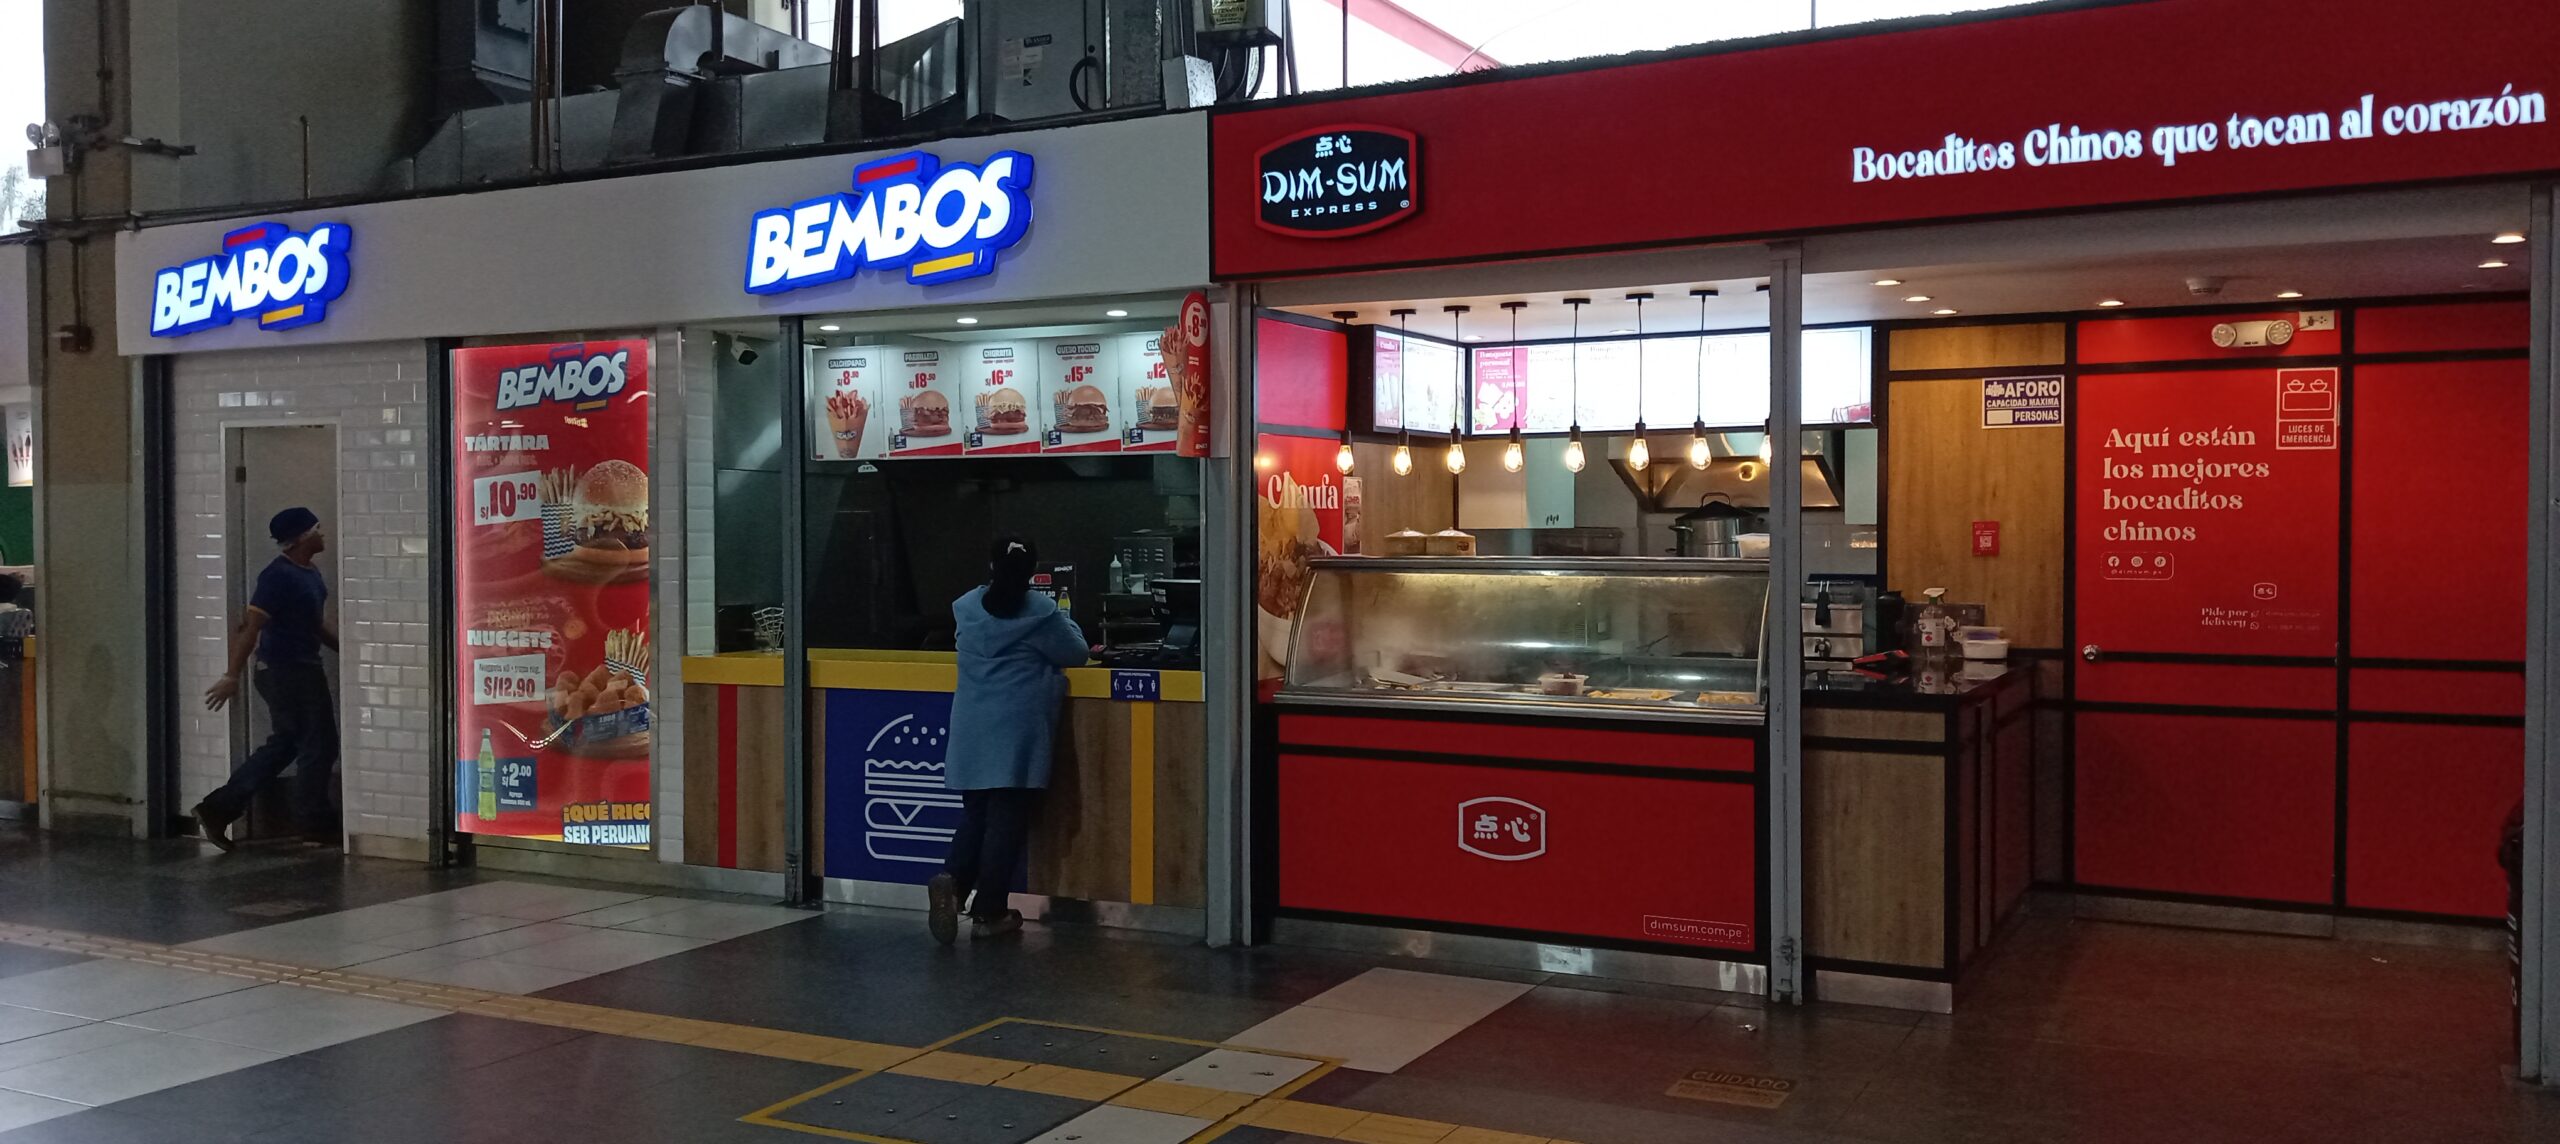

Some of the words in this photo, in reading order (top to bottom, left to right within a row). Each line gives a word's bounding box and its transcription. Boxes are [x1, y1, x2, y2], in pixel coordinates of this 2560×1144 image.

[1853, 133, 2015, 183] Bocaditos
[2024, 123, 2143, 167] Chinos
[2152, 122, 2218, 167] que
[2227, 112, 2331, 150] tocan
[2340, 94, 2374, 140] al
[2382, 83, 2547, 136] corazón
[1262, 157, 1406, 204] DIM-SUM
[1291, 202, 1378, 217] EXPRESS
[749, 156, 1014, 288] BEMBOS
[152, 228, 330, 332] BEMBOS
[496, 351, 628, 410] BEMBOS
[2004, 380, 2060, 398] AFORO
[1986, 399, 2027, 409] CAPACIDAD
[2029, 397, 2059, 407] MAXIMA
[2014, 410, 2059, 422] PERSONAS
[2288, 425, 2313, 433] LUCES
[2315, 425, 2325, 433] DE
[464, 433, 550, 452] TÁRTARA
[2104, 427, 2169, 454] Aquí
[2178, 425, 2256, 446] están
[2281, 435, 2331, 443] EMERGENCIA
[2103, 457, 2144, 479] los
[2151, 457, 2270, 485] mejores
[1267, 471, 1339, 510] Chaufa
[2103, 487, 2244, 510] bocaditos
[2103, 519, 2197, 541] chinos
[2201, 607, 2226, 616] Pide
[2228, 609, 2248, 619] por
[2201, 617, 2247, 628] delivery
[467, 630, 553, 649] NUGGETS
[564, 825, 589, 844] SER
[1473, 814, 1531, 843] 点心
[1650, 920, 1742, 939] dimsum.com.pe
[1691, 1071, 1790, 1090] CUIDADO
